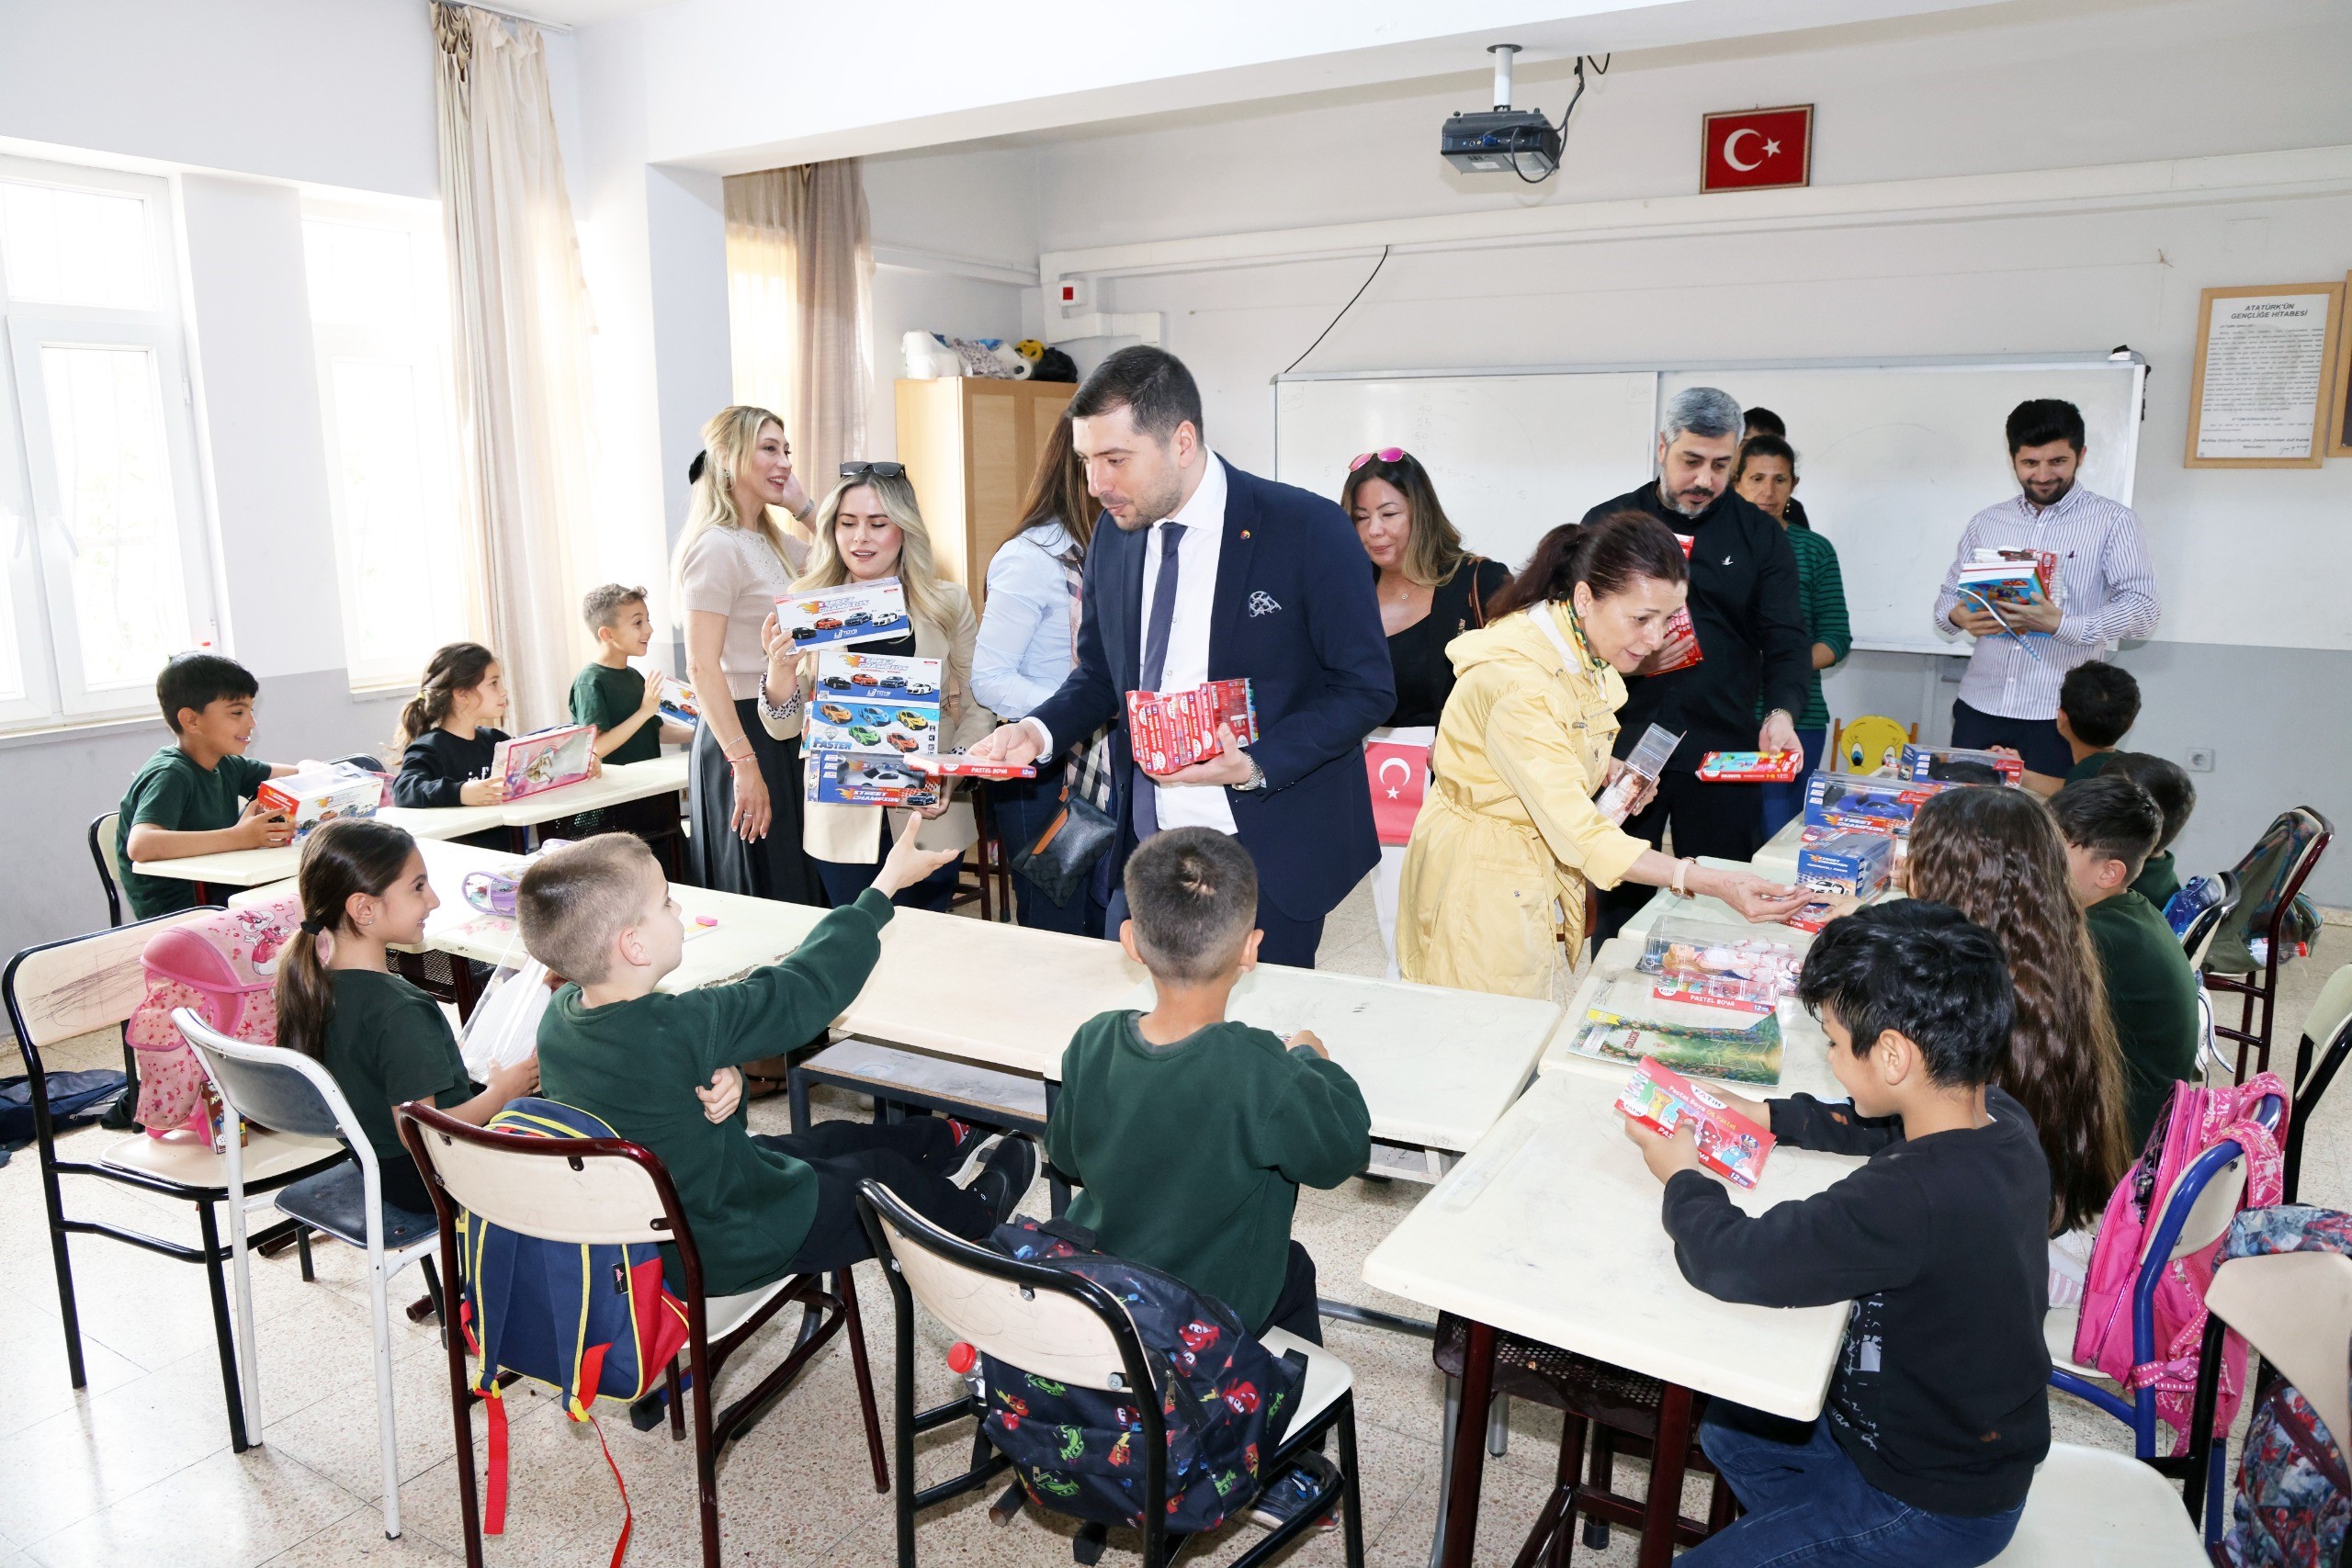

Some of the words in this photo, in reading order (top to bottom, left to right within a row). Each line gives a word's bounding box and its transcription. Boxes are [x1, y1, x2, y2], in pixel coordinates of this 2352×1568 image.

[2231, 311, 2269, 320] GENÇLİĞE
[2271, 309, 2308, 318] HİTABESİ
[812, 736, 853, 750] FASTER
[1838, 821, 1886, 832] CHAMPION
[1690, 994, 1714, 1004] PASTEL
[1668, 1085, 1689, 1101] Pastel
[1690, 1098, 1706, 1112] Boya
[1716, 1113, 1736, 1131] Pastel
[1657, 1126, 1674, 1140] PAS
[1699, 1151, 1710, 1163] YA
[1730, 1171, 1741, 1182] 12
